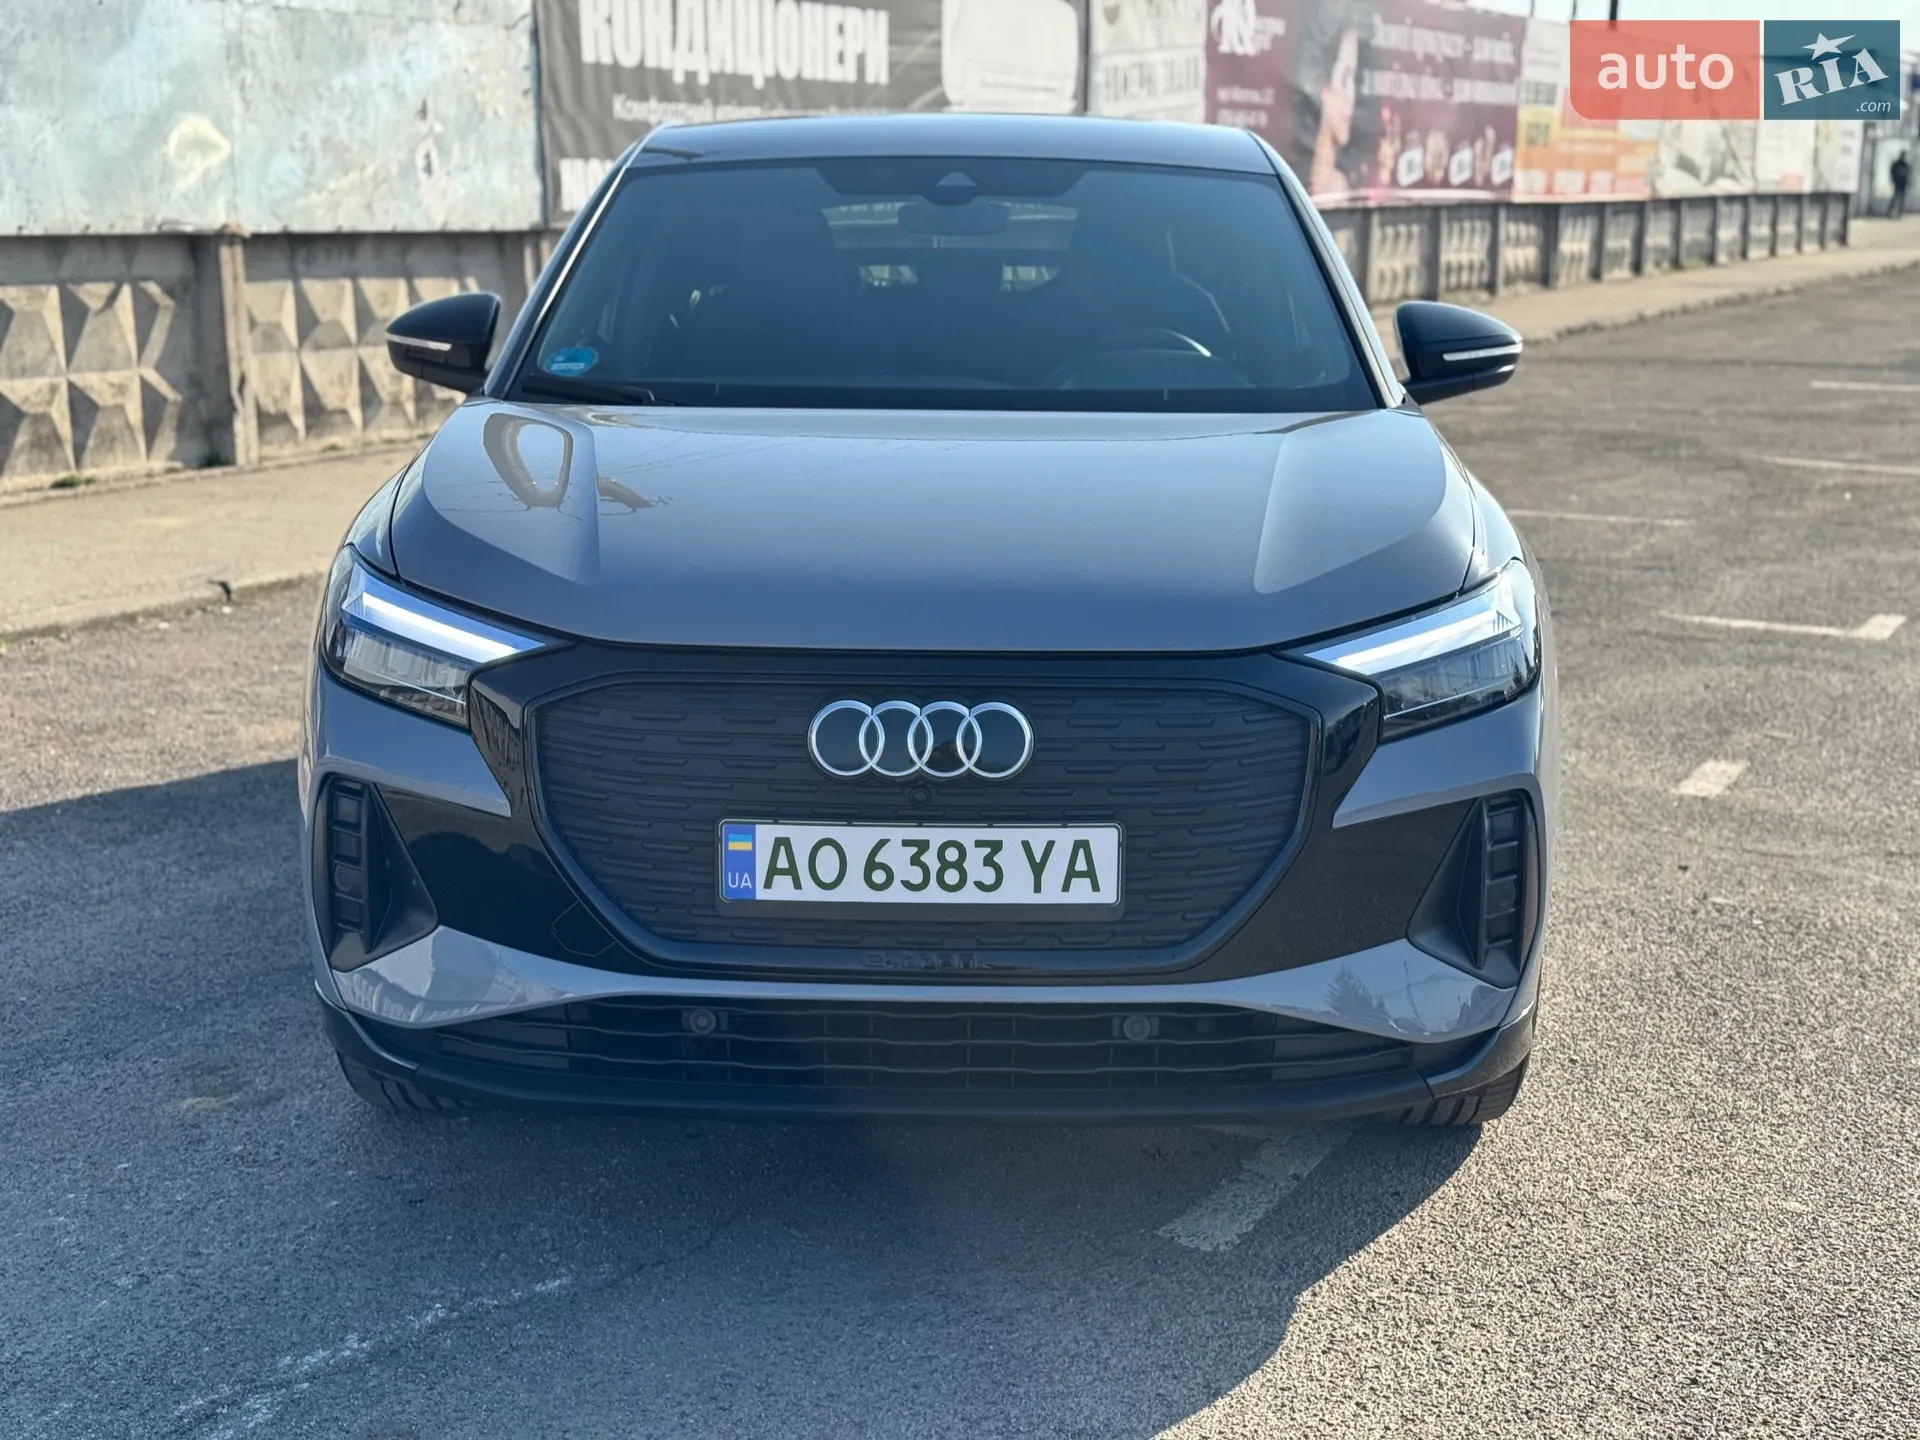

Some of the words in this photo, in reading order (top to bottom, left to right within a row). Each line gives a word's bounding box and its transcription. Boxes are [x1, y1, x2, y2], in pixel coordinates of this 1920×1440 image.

[579, 0, 889, 89] КОНДИЦІОНЕРИ
[728, 872, 752, 890] UA
[763, 837, 847, 891] AO
[863, 839, 1004, 893] 6383
[1020, 839, 1101, 893] YA
